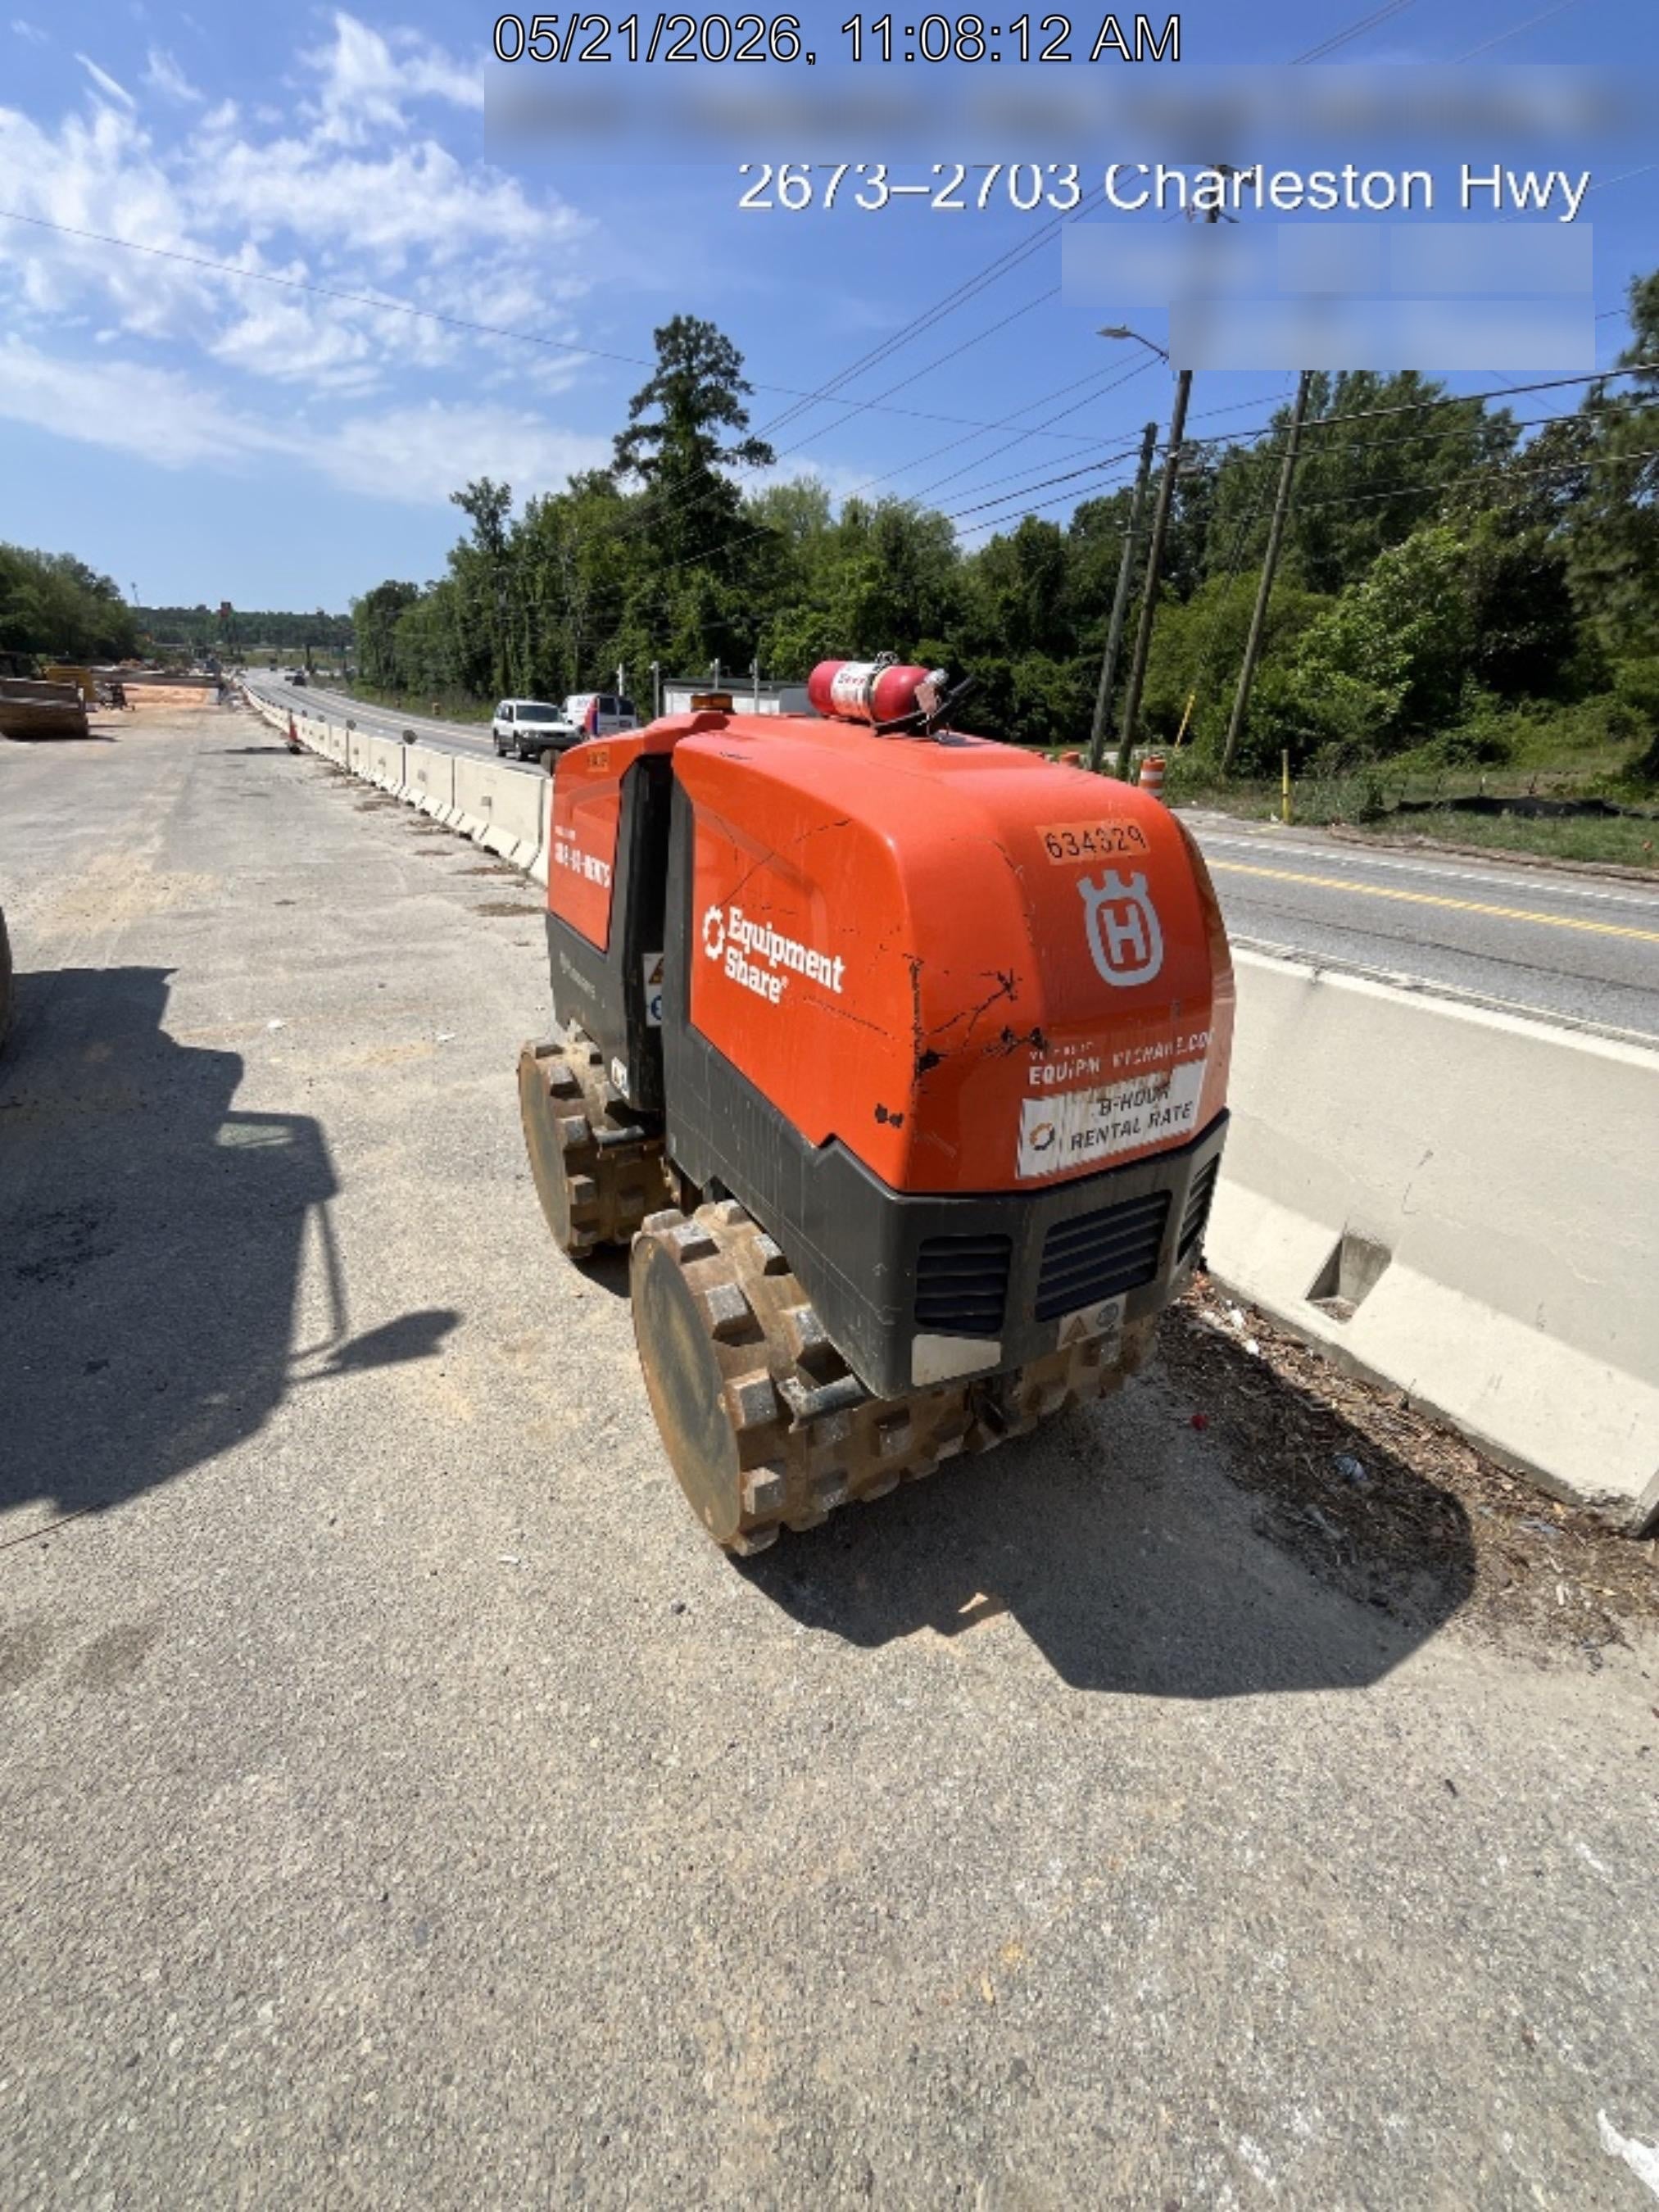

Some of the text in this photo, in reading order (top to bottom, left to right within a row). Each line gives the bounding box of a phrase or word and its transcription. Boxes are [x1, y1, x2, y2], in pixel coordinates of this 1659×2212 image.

[728, 906, 845, 994] Equipment
[1071, 1101, 1194, 1150] RENTAL RATE
